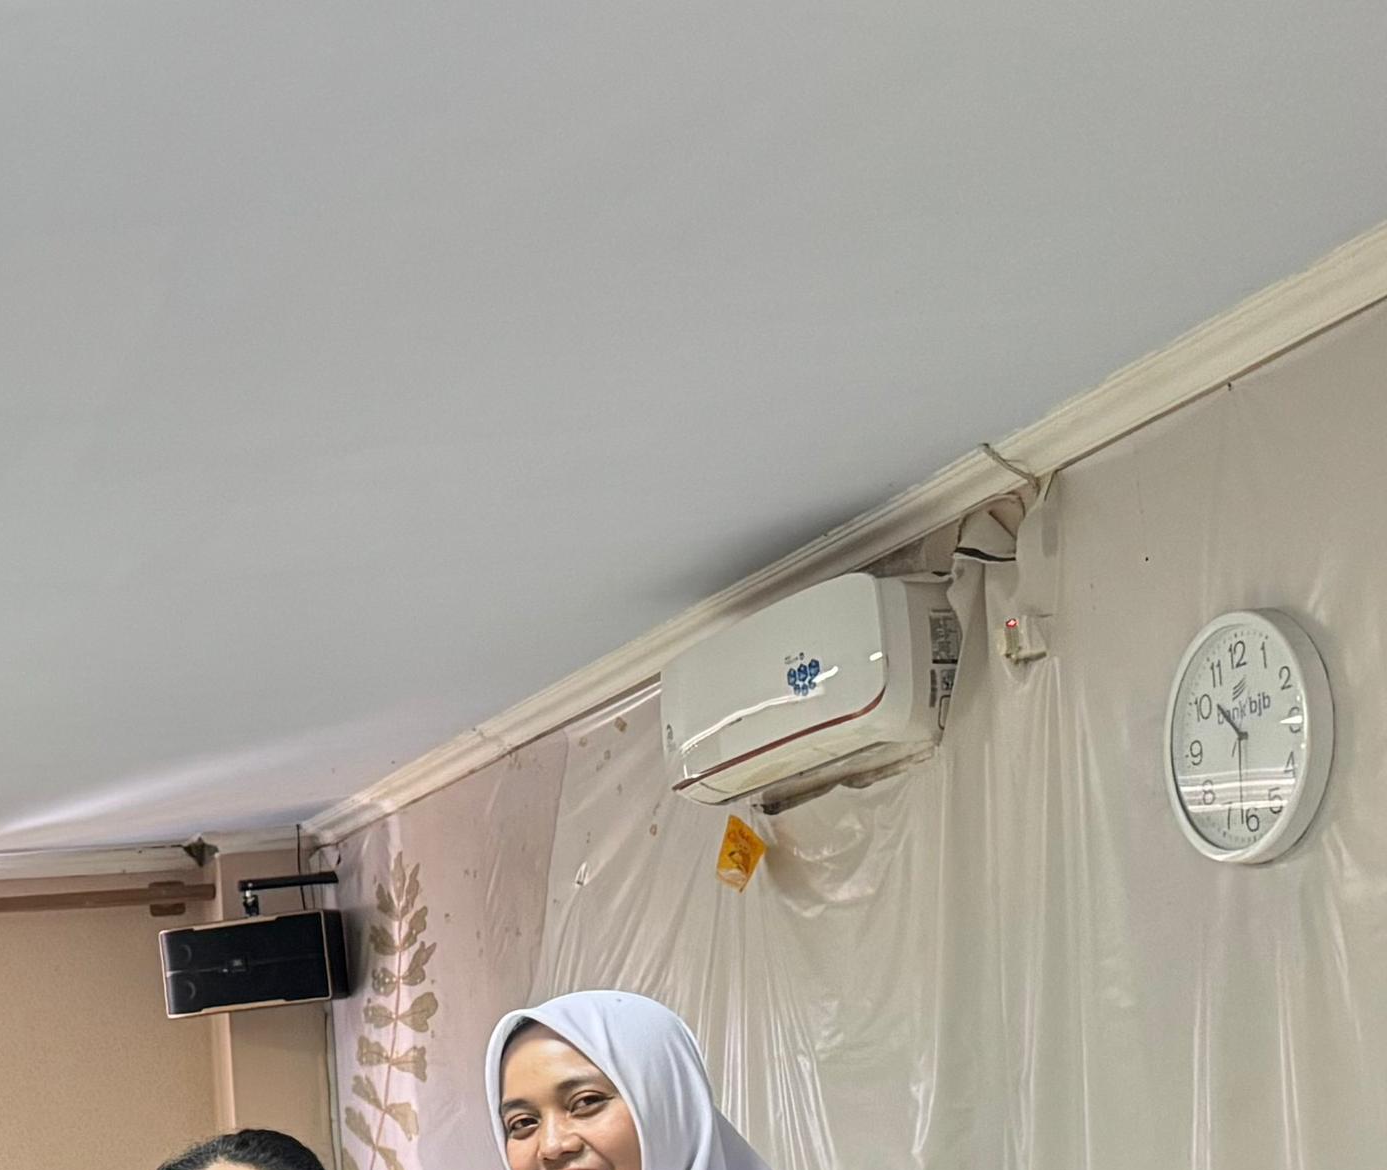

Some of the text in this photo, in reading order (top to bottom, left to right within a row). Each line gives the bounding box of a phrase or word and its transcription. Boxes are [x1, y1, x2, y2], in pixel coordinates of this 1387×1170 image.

[1229, 641, 1247, 669] 12
[1260, 642, 1267, 668] 1
[1211, 660, 1223, 688] 11
[1279, 666, 1292, 690] 2
[1195, 694, 1212, 722] 10
[1249, 692, 1270, 717] bjb
[1190, 740, 1203, 766] 9
[1284, 751, 1296, 778] 4
[1203, 780, 1215, 806] 8
[1268, 788, 1283, 814] 5
[1246, 808, 1260, 832] 6
